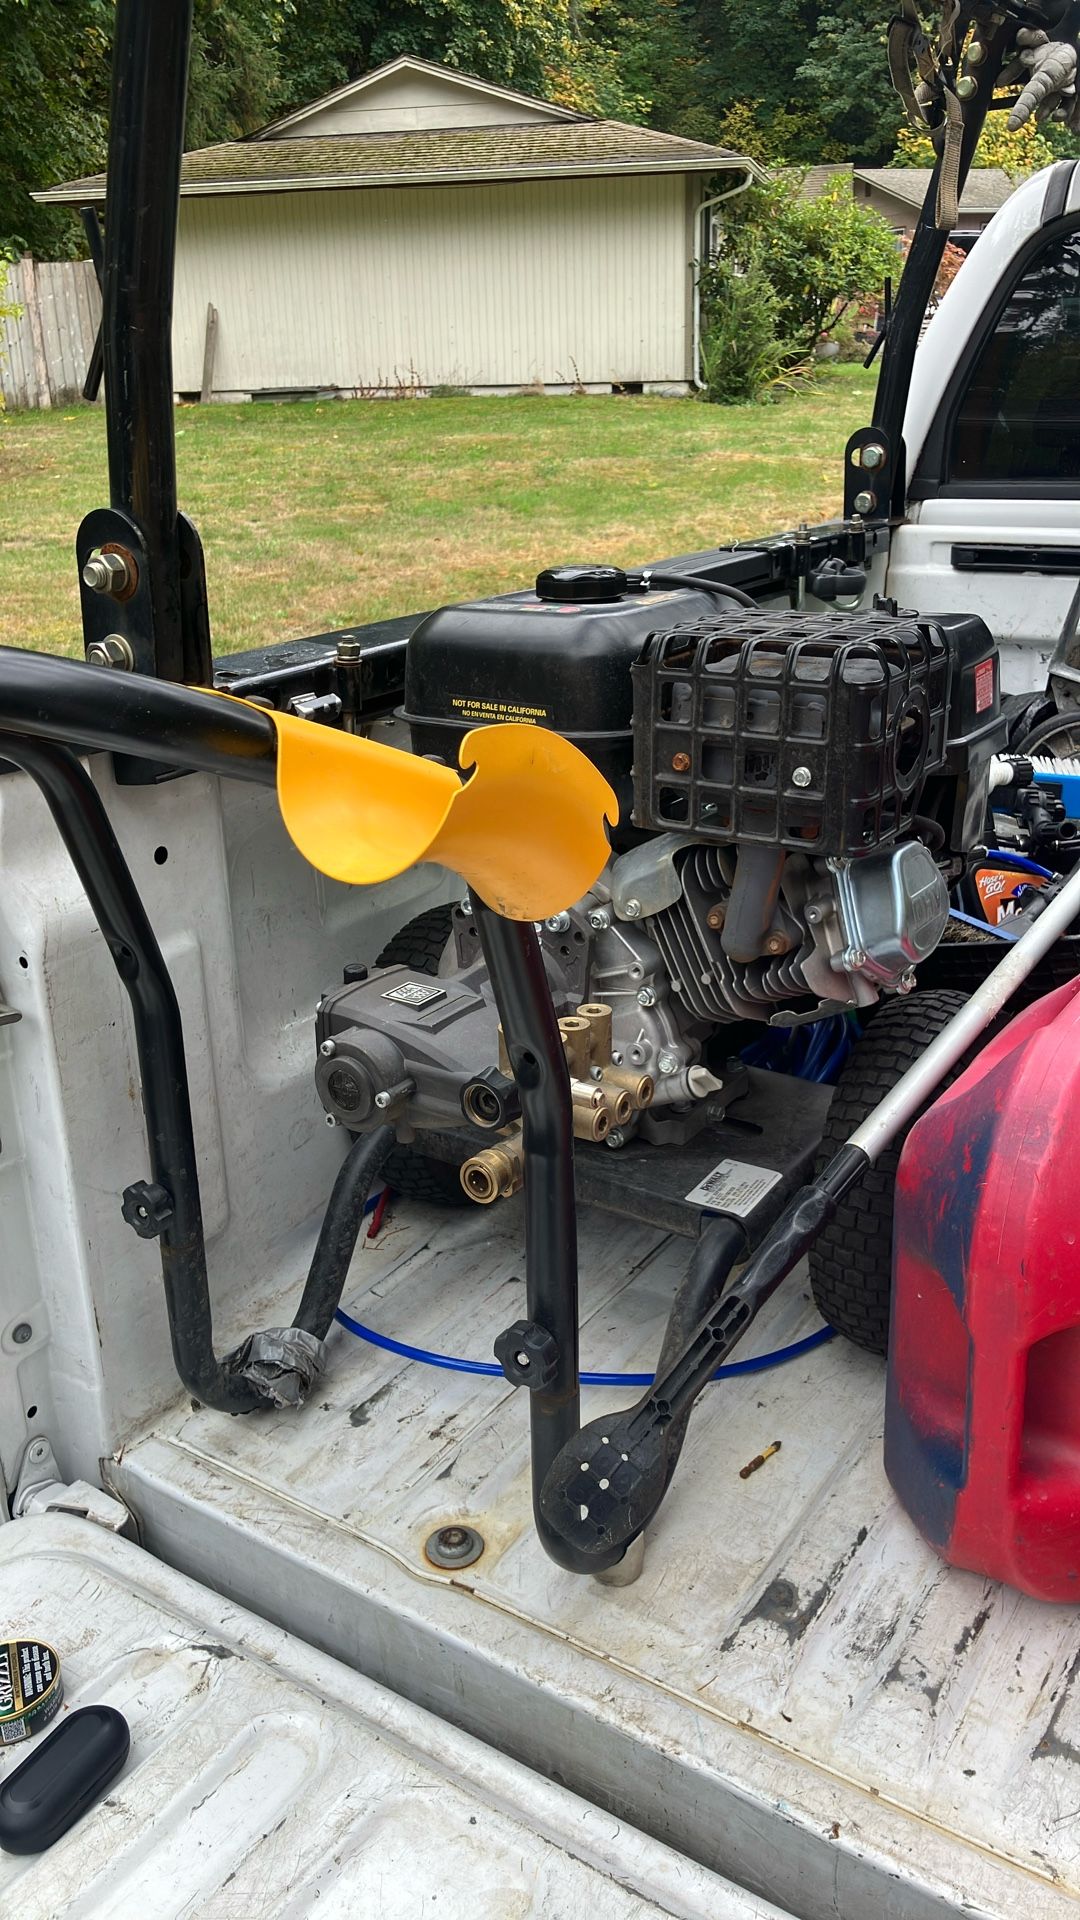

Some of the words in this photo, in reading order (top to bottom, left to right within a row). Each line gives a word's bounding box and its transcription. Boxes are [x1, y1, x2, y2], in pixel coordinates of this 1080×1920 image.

[452, 699, 466, 708] NOT
[467, 700, 481, 709] FOR
[481, 702, 498, 711] SALE
[499, 704, 507, 712] IN
[507, 705, 547, 717] CALIFORNIA
[505, 715, 537, 724] CALIFORNIA
[986, 880, 1006, 894] GO!
